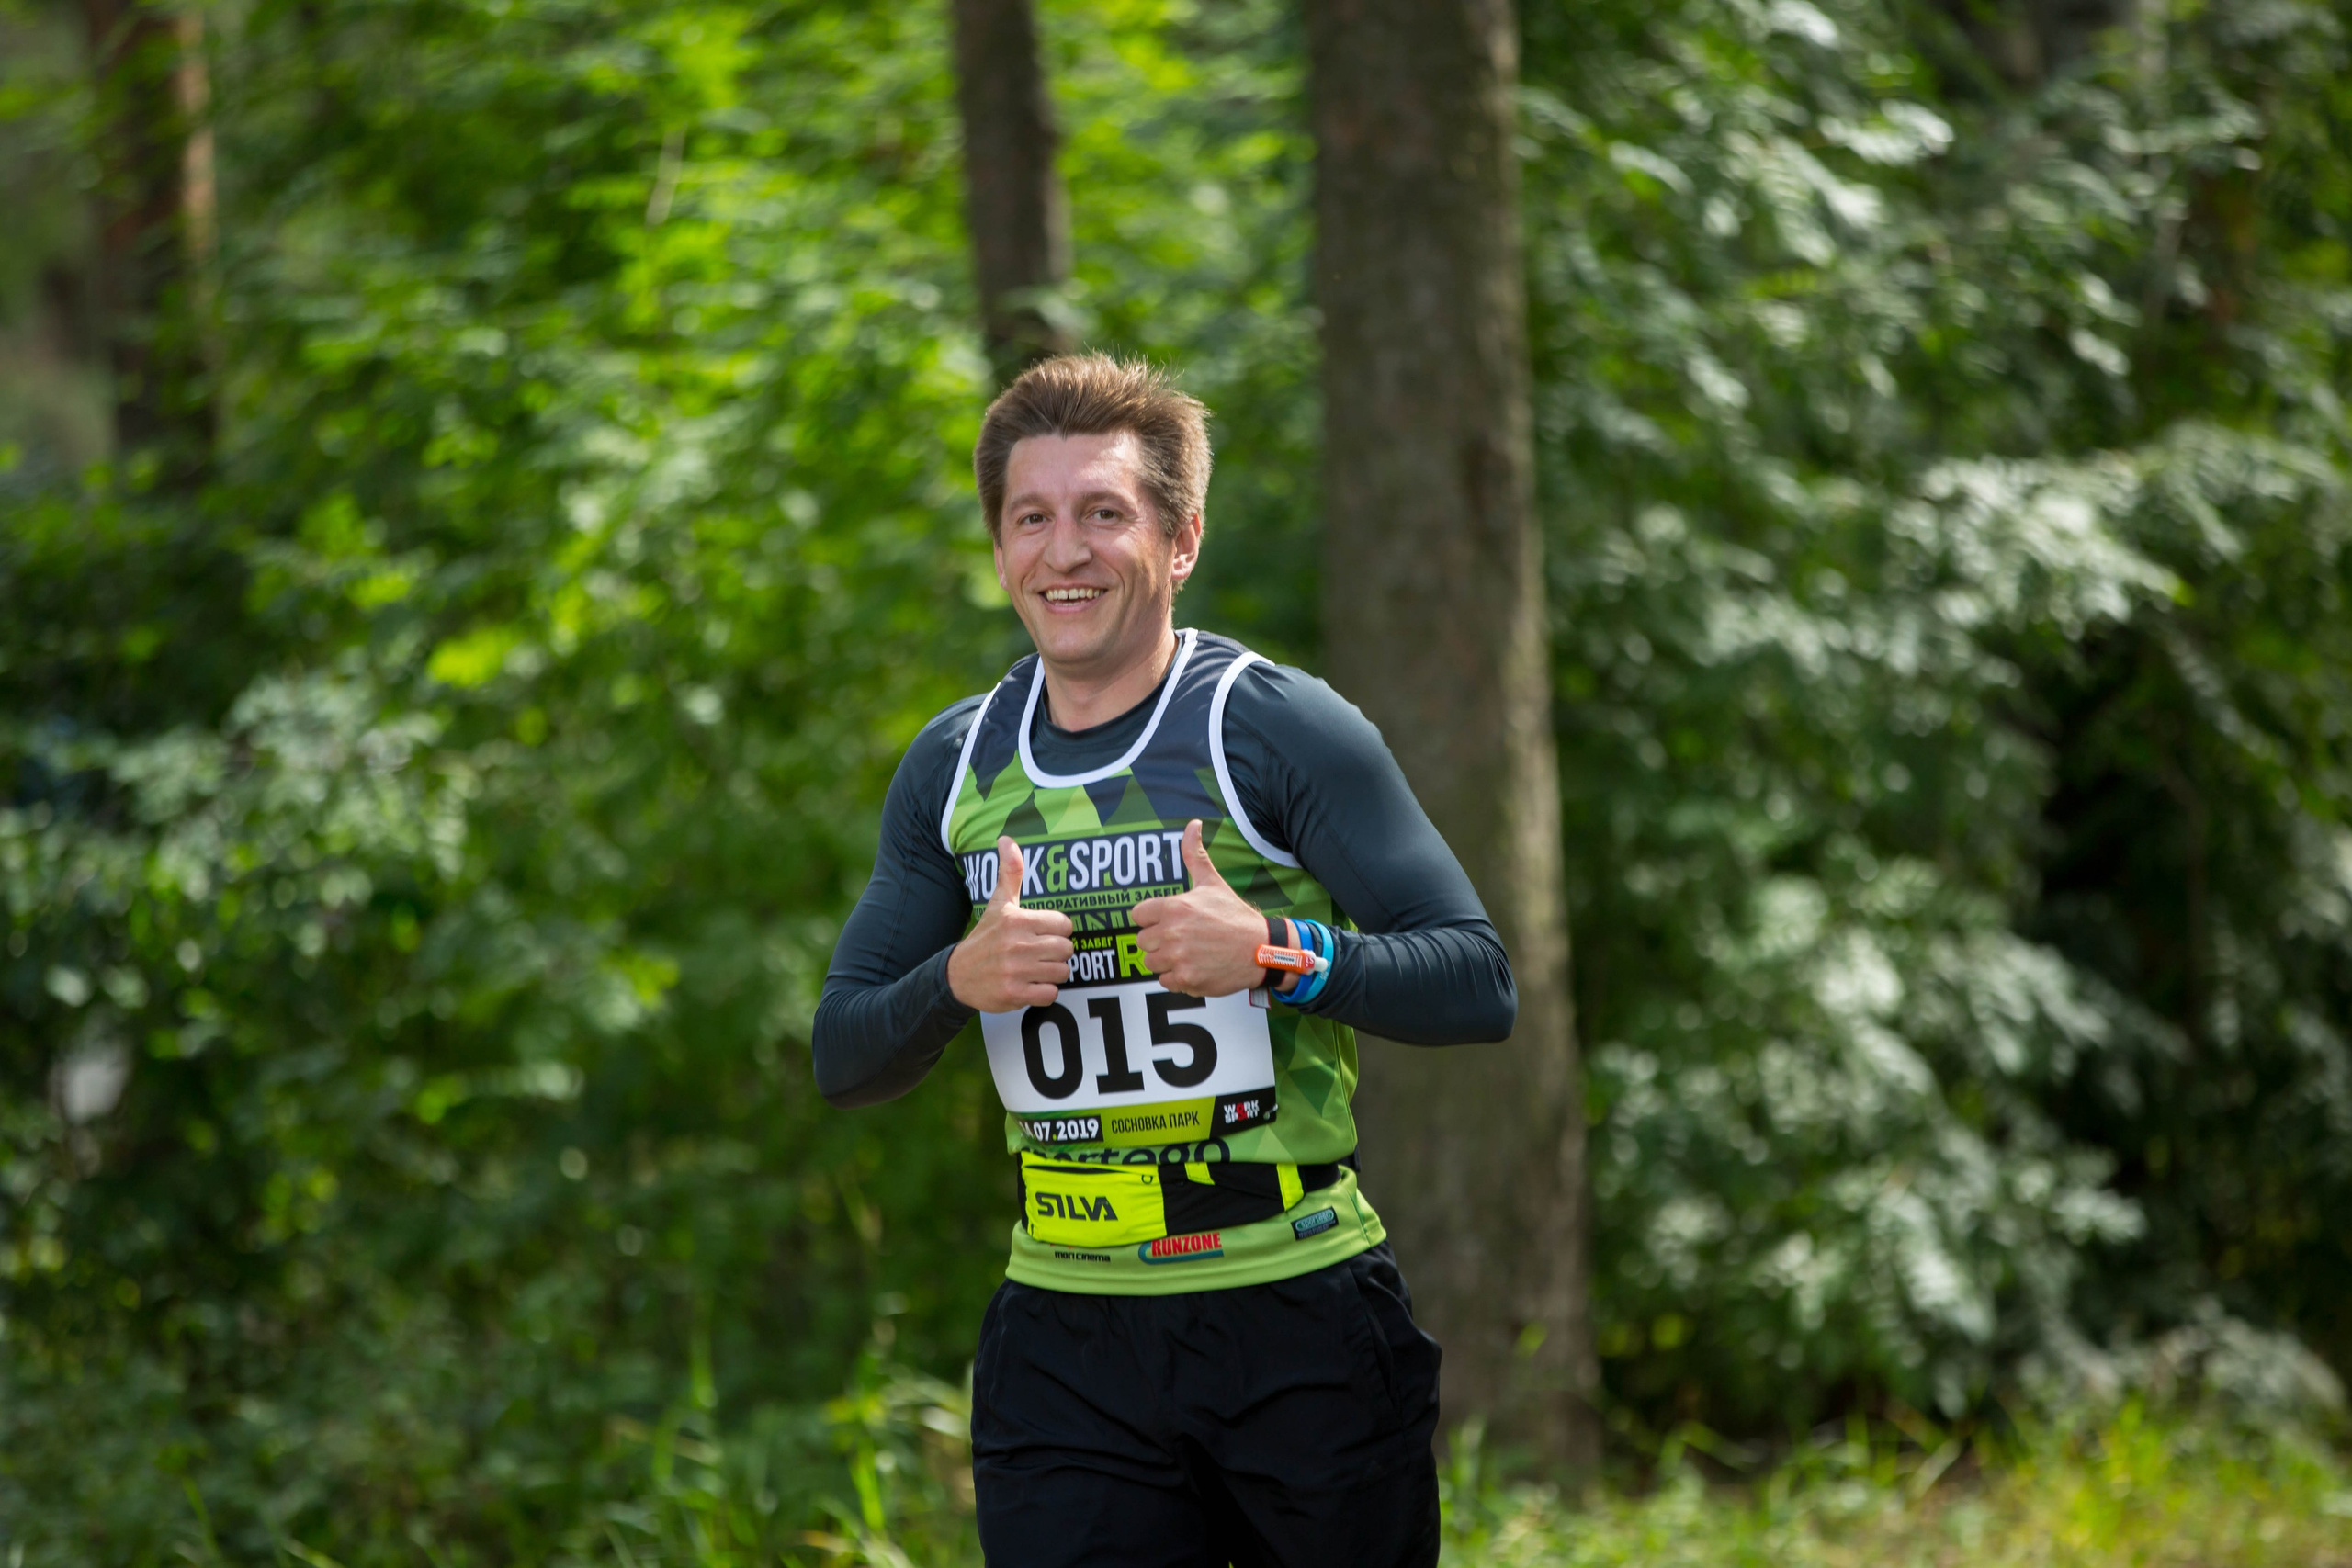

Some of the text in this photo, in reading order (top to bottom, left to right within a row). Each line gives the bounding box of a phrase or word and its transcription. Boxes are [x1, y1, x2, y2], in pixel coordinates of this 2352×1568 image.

[963, 831, 1185, 901] WOK&SPORT
[1067, 949, 1115, 983] PORT
[1021, 992, 1218, 1100] 015
[1111, 1111, 1200, 1134] СОСНОВКА ПАРК
[1036, 1191, 1118, 1222] SILVA
[1150, 1232, 1222, 1258] RUNZONE
